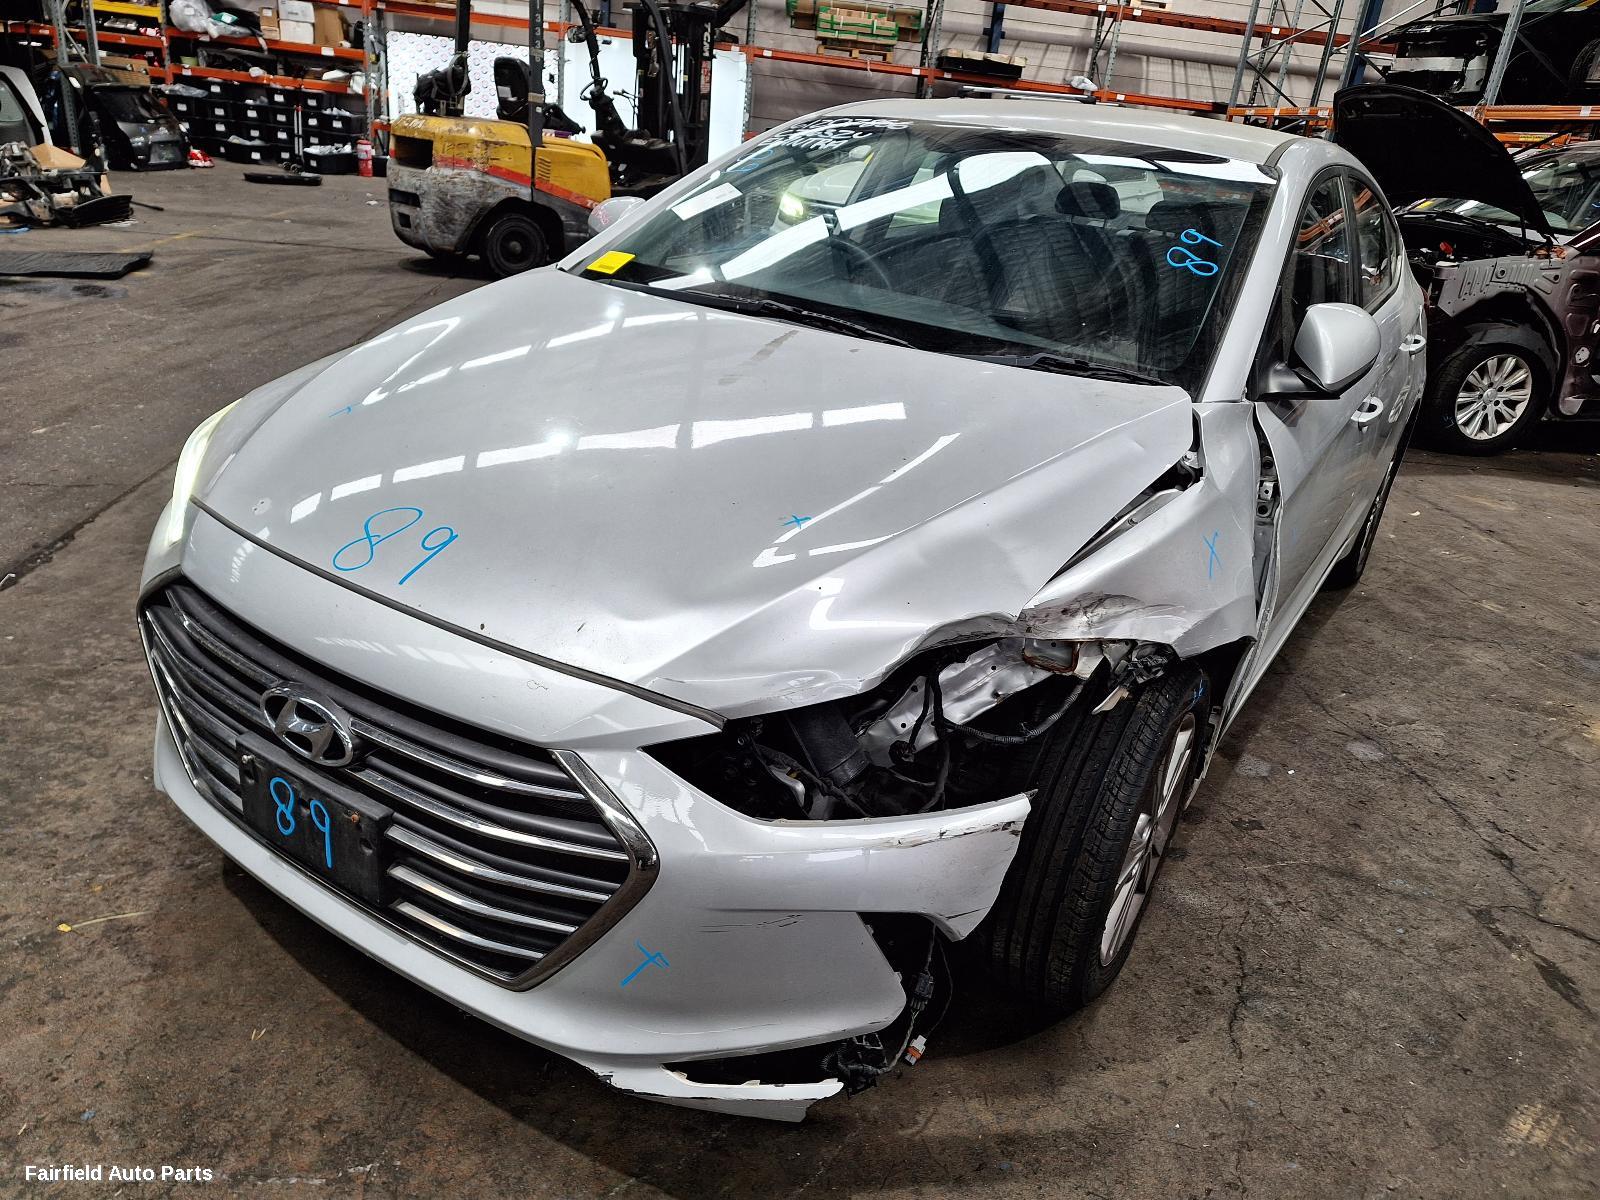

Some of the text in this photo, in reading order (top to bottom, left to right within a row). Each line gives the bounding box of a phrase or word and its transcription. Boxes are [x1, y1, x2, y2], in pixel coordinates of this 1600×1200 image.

[1166, 228, 1224, 276] 89
[332, 506, 459, 585] 89
[269, 776, 332, 869] 89
